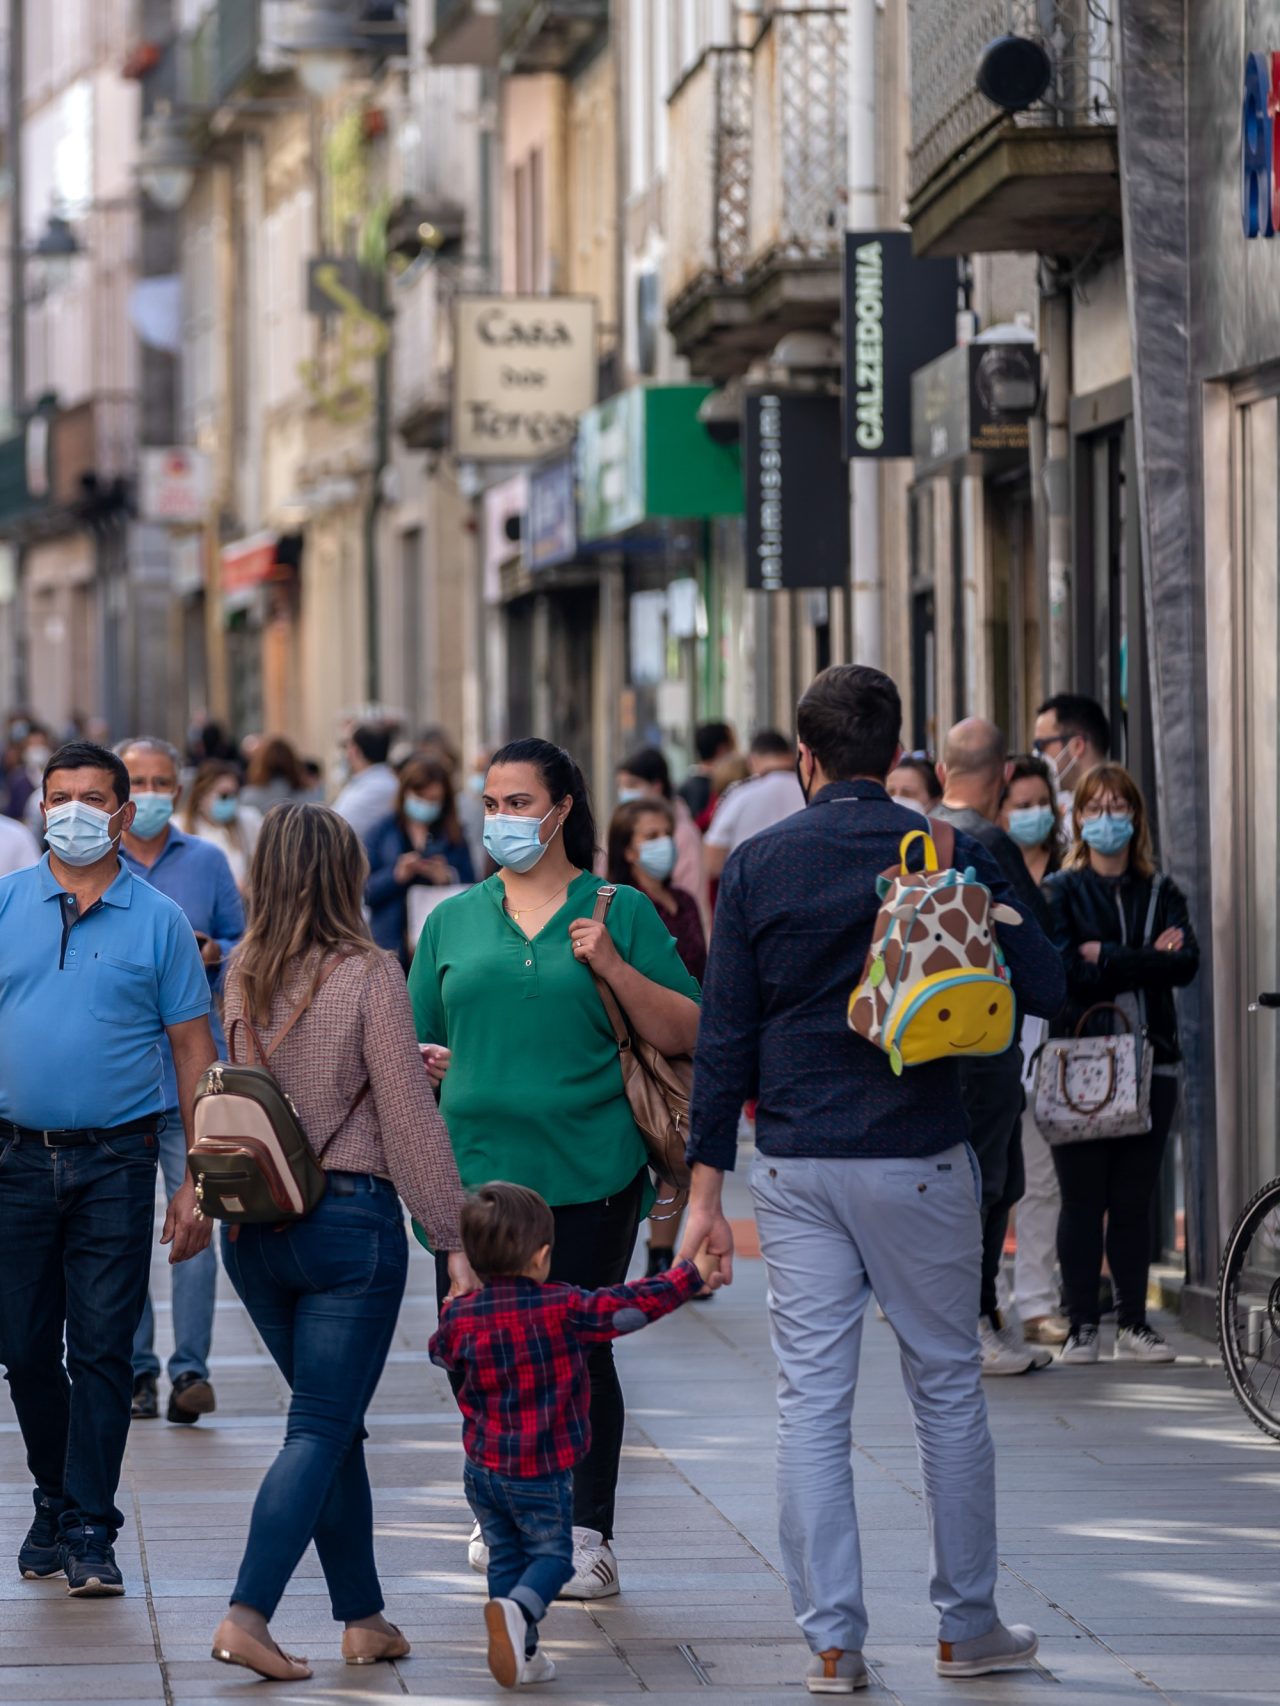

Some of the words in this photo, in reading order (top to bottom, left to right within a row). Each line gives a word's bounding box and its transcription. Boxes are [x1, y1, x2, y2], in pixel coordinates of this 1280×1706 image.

[476, 307, 574, 348] Casa
[855, 240, 884, 450] CALZEDONIA
[757, 394, 782, 590] intimissimi
